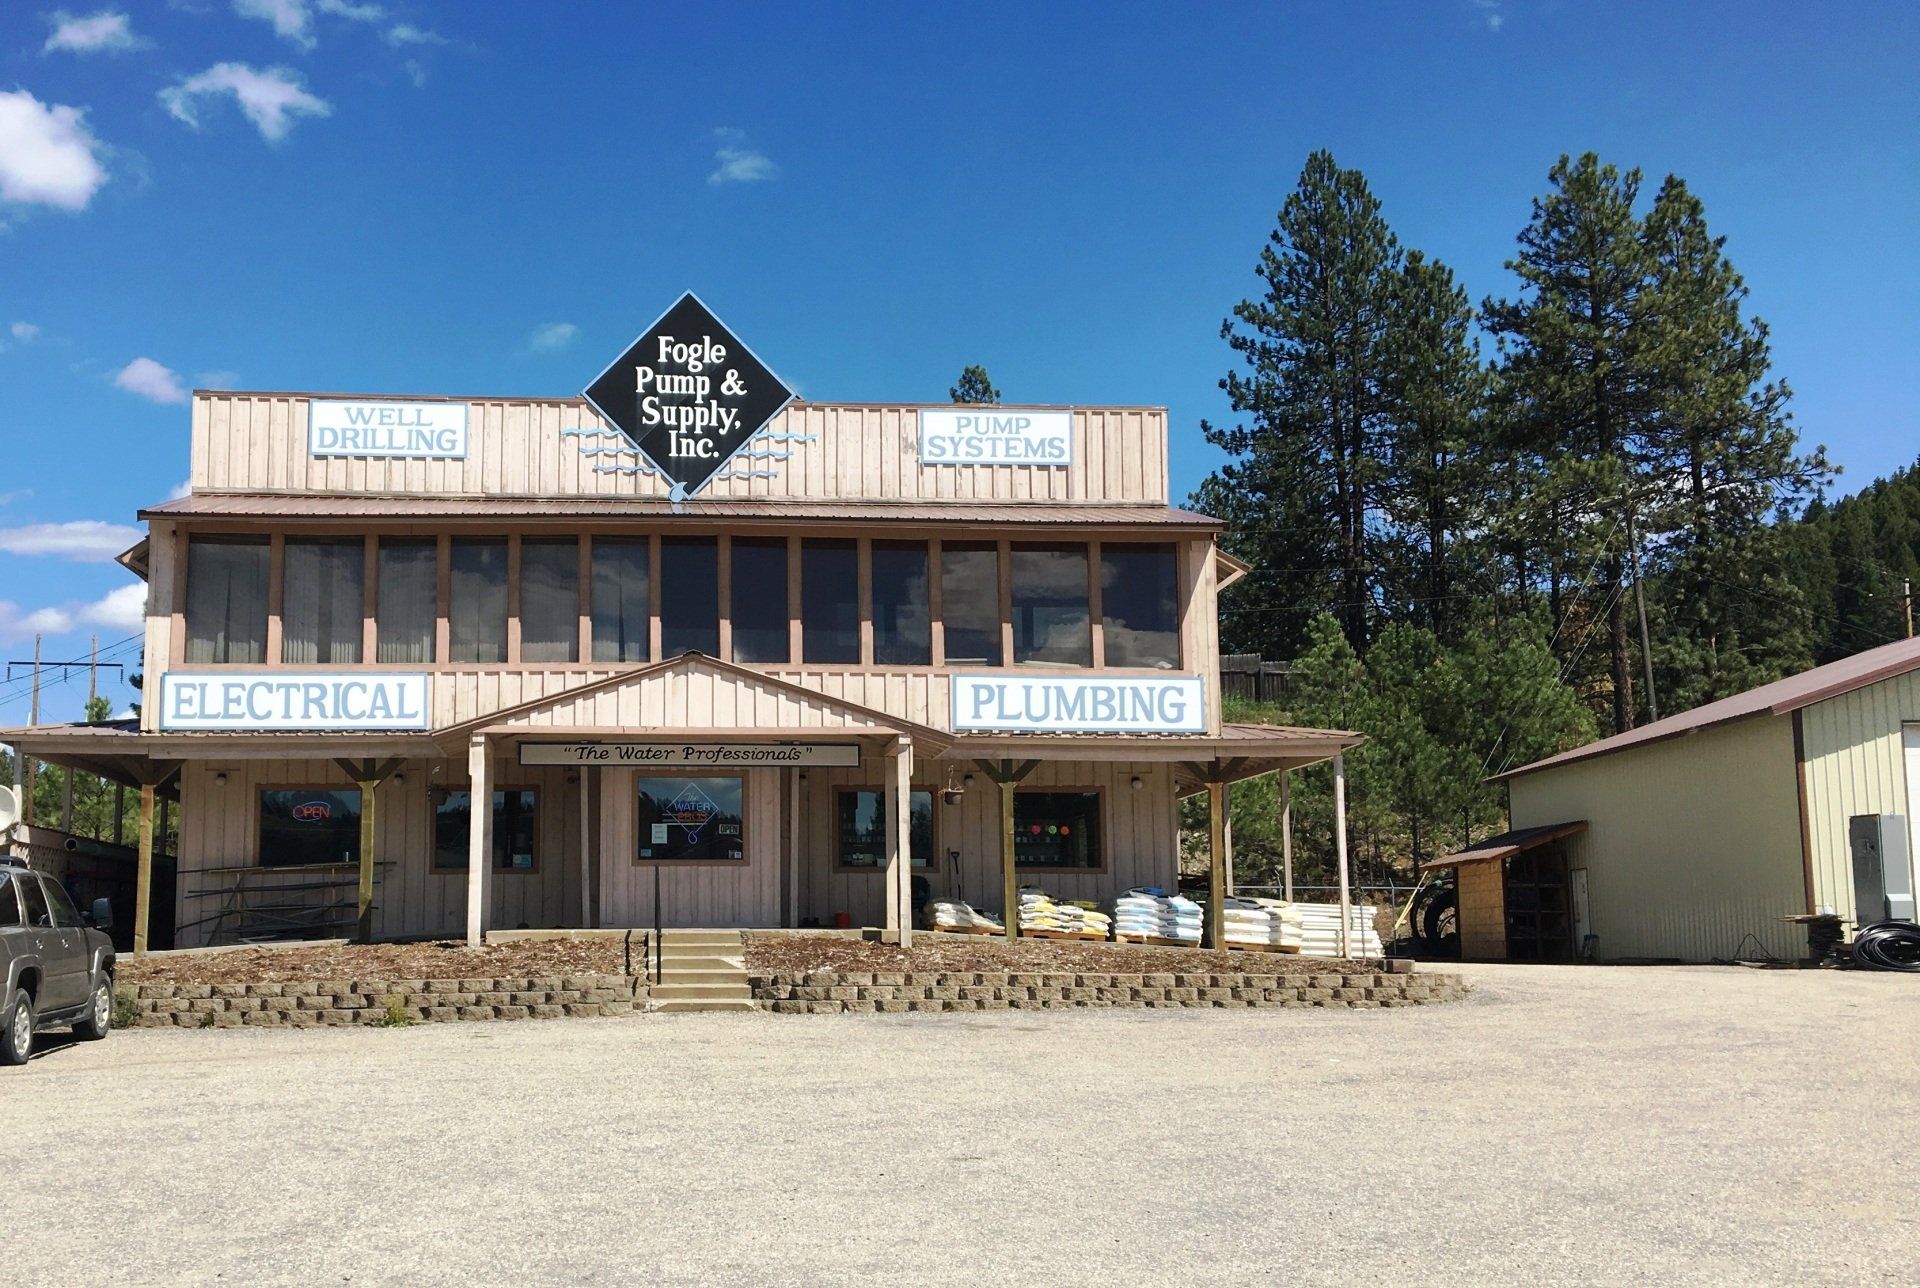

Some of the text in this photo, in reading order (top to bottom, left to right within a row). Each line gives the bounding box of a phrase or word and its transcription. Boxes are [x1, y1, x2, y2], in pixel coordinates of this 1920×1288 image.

[657, 335, 727, 373] Fogle
[635, 366, 748, 404] Pump &
[343, 407, 433, 426] WELL
[641, 396, 742, 435] Supply,
[955, 416, 1031, 435] PUMP
[318, 427, 458, 451] DRILLING
[668, 430, 720, 458] Inc.
[928, 435, 1066, 459] SYSTEMS
[172, 681, 419, 720] ELECTRICAL
[971, 684, 1187, 724] PLUMBING
[615, 746, 676, 760] Water
[292, 805, 330, 818] OPEN
[673, 802, 711, 812] WATER
[720, 825, 739, 834] OPEN
